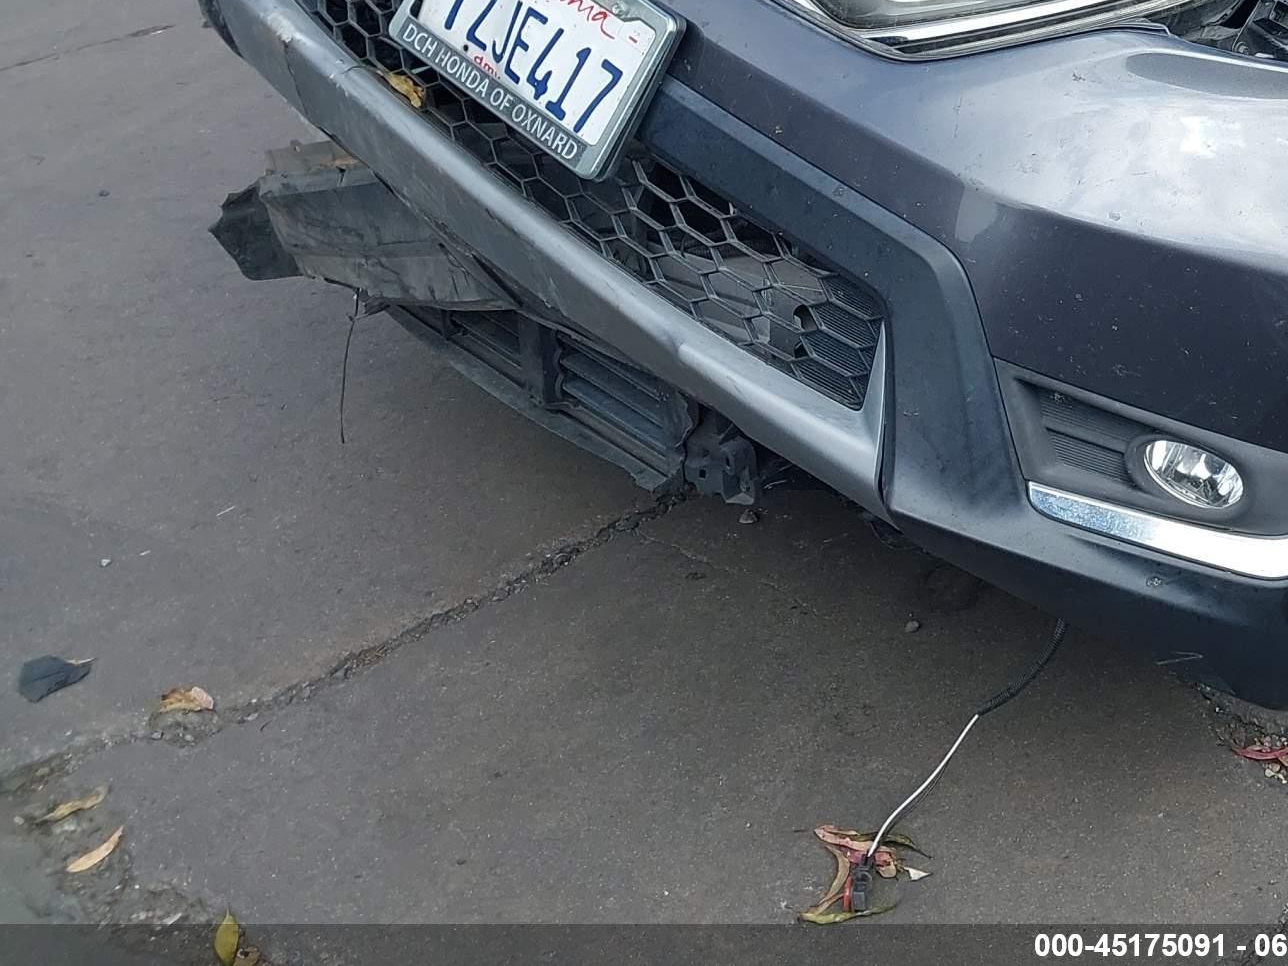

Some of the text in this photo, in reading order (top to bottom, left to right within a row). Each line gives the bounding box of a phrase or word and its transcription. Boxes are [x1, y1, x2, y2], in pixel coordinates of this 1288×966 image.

[402, 24, 579, 161] DCH HONDA OF OXNARD
